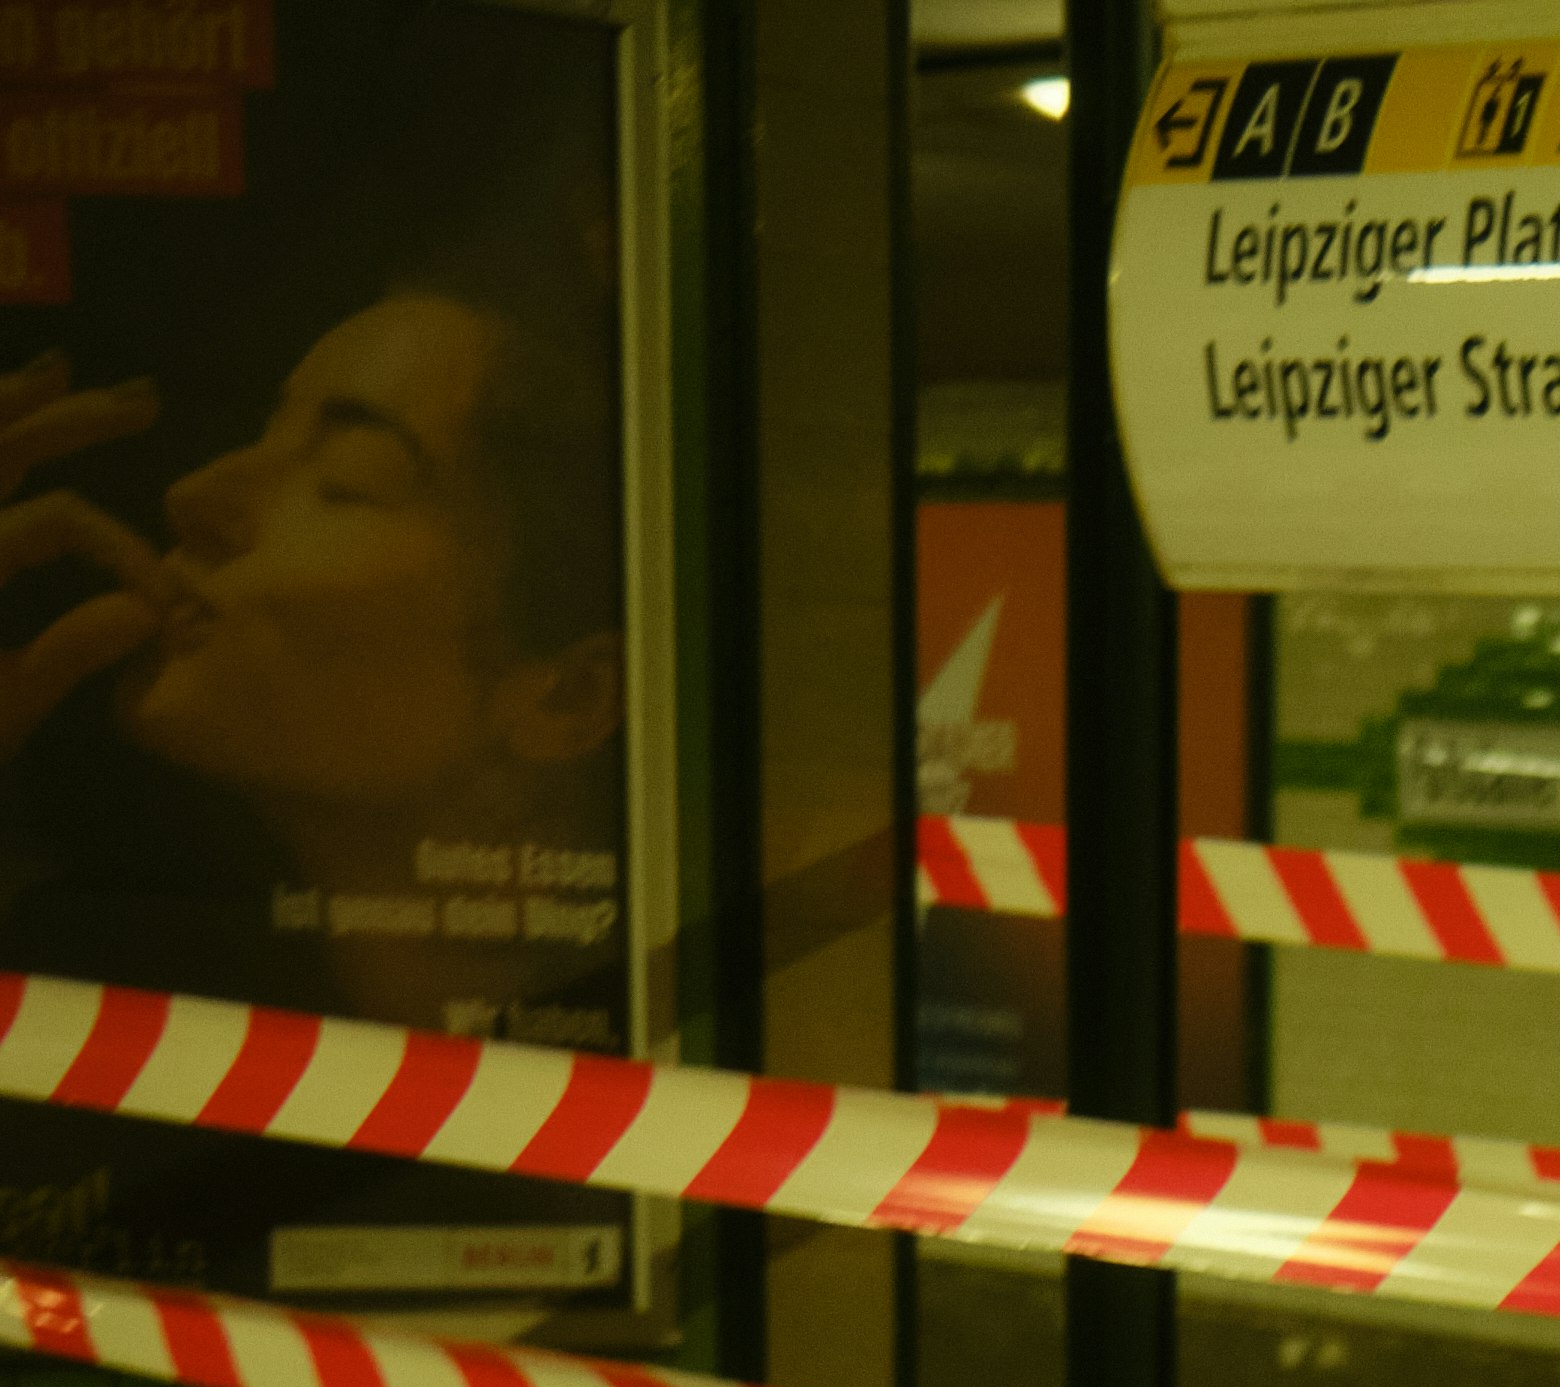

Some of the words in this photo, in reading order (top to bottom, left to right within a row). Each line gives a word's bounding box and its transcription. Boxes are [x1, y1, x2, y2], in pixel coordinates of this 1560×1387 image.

[1232, 83, 1278, 160] A
[1315, 78, 1364, 153] B
[1205, 200, 1447, 305] Leipziger
[1205, 334, 1442, 443] Leipziger
